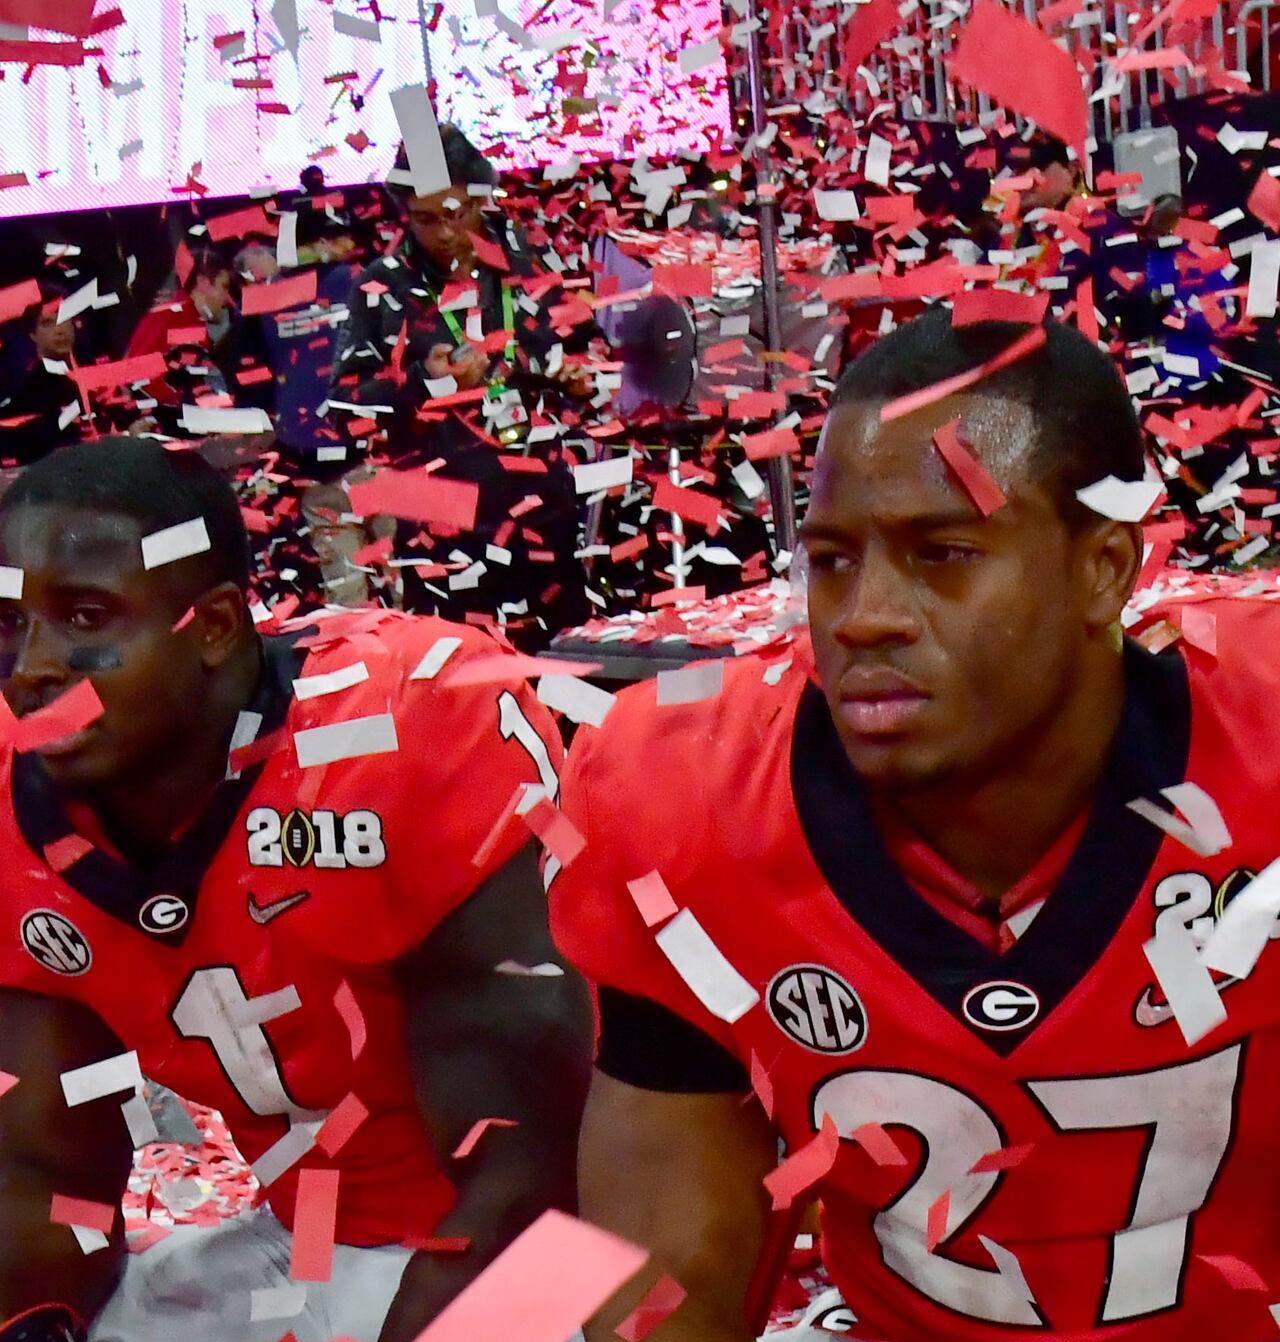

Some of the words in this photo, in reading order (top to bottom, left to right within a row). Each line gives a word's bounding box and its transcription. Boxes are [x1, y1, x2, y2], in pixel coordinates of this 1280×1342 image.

[25, 911, 89, 973] SEC
[170, 964, 332, 1135] 1
[770, 967, 865, 1050] SEC
[811, 1043, 1247, 1330] 27
